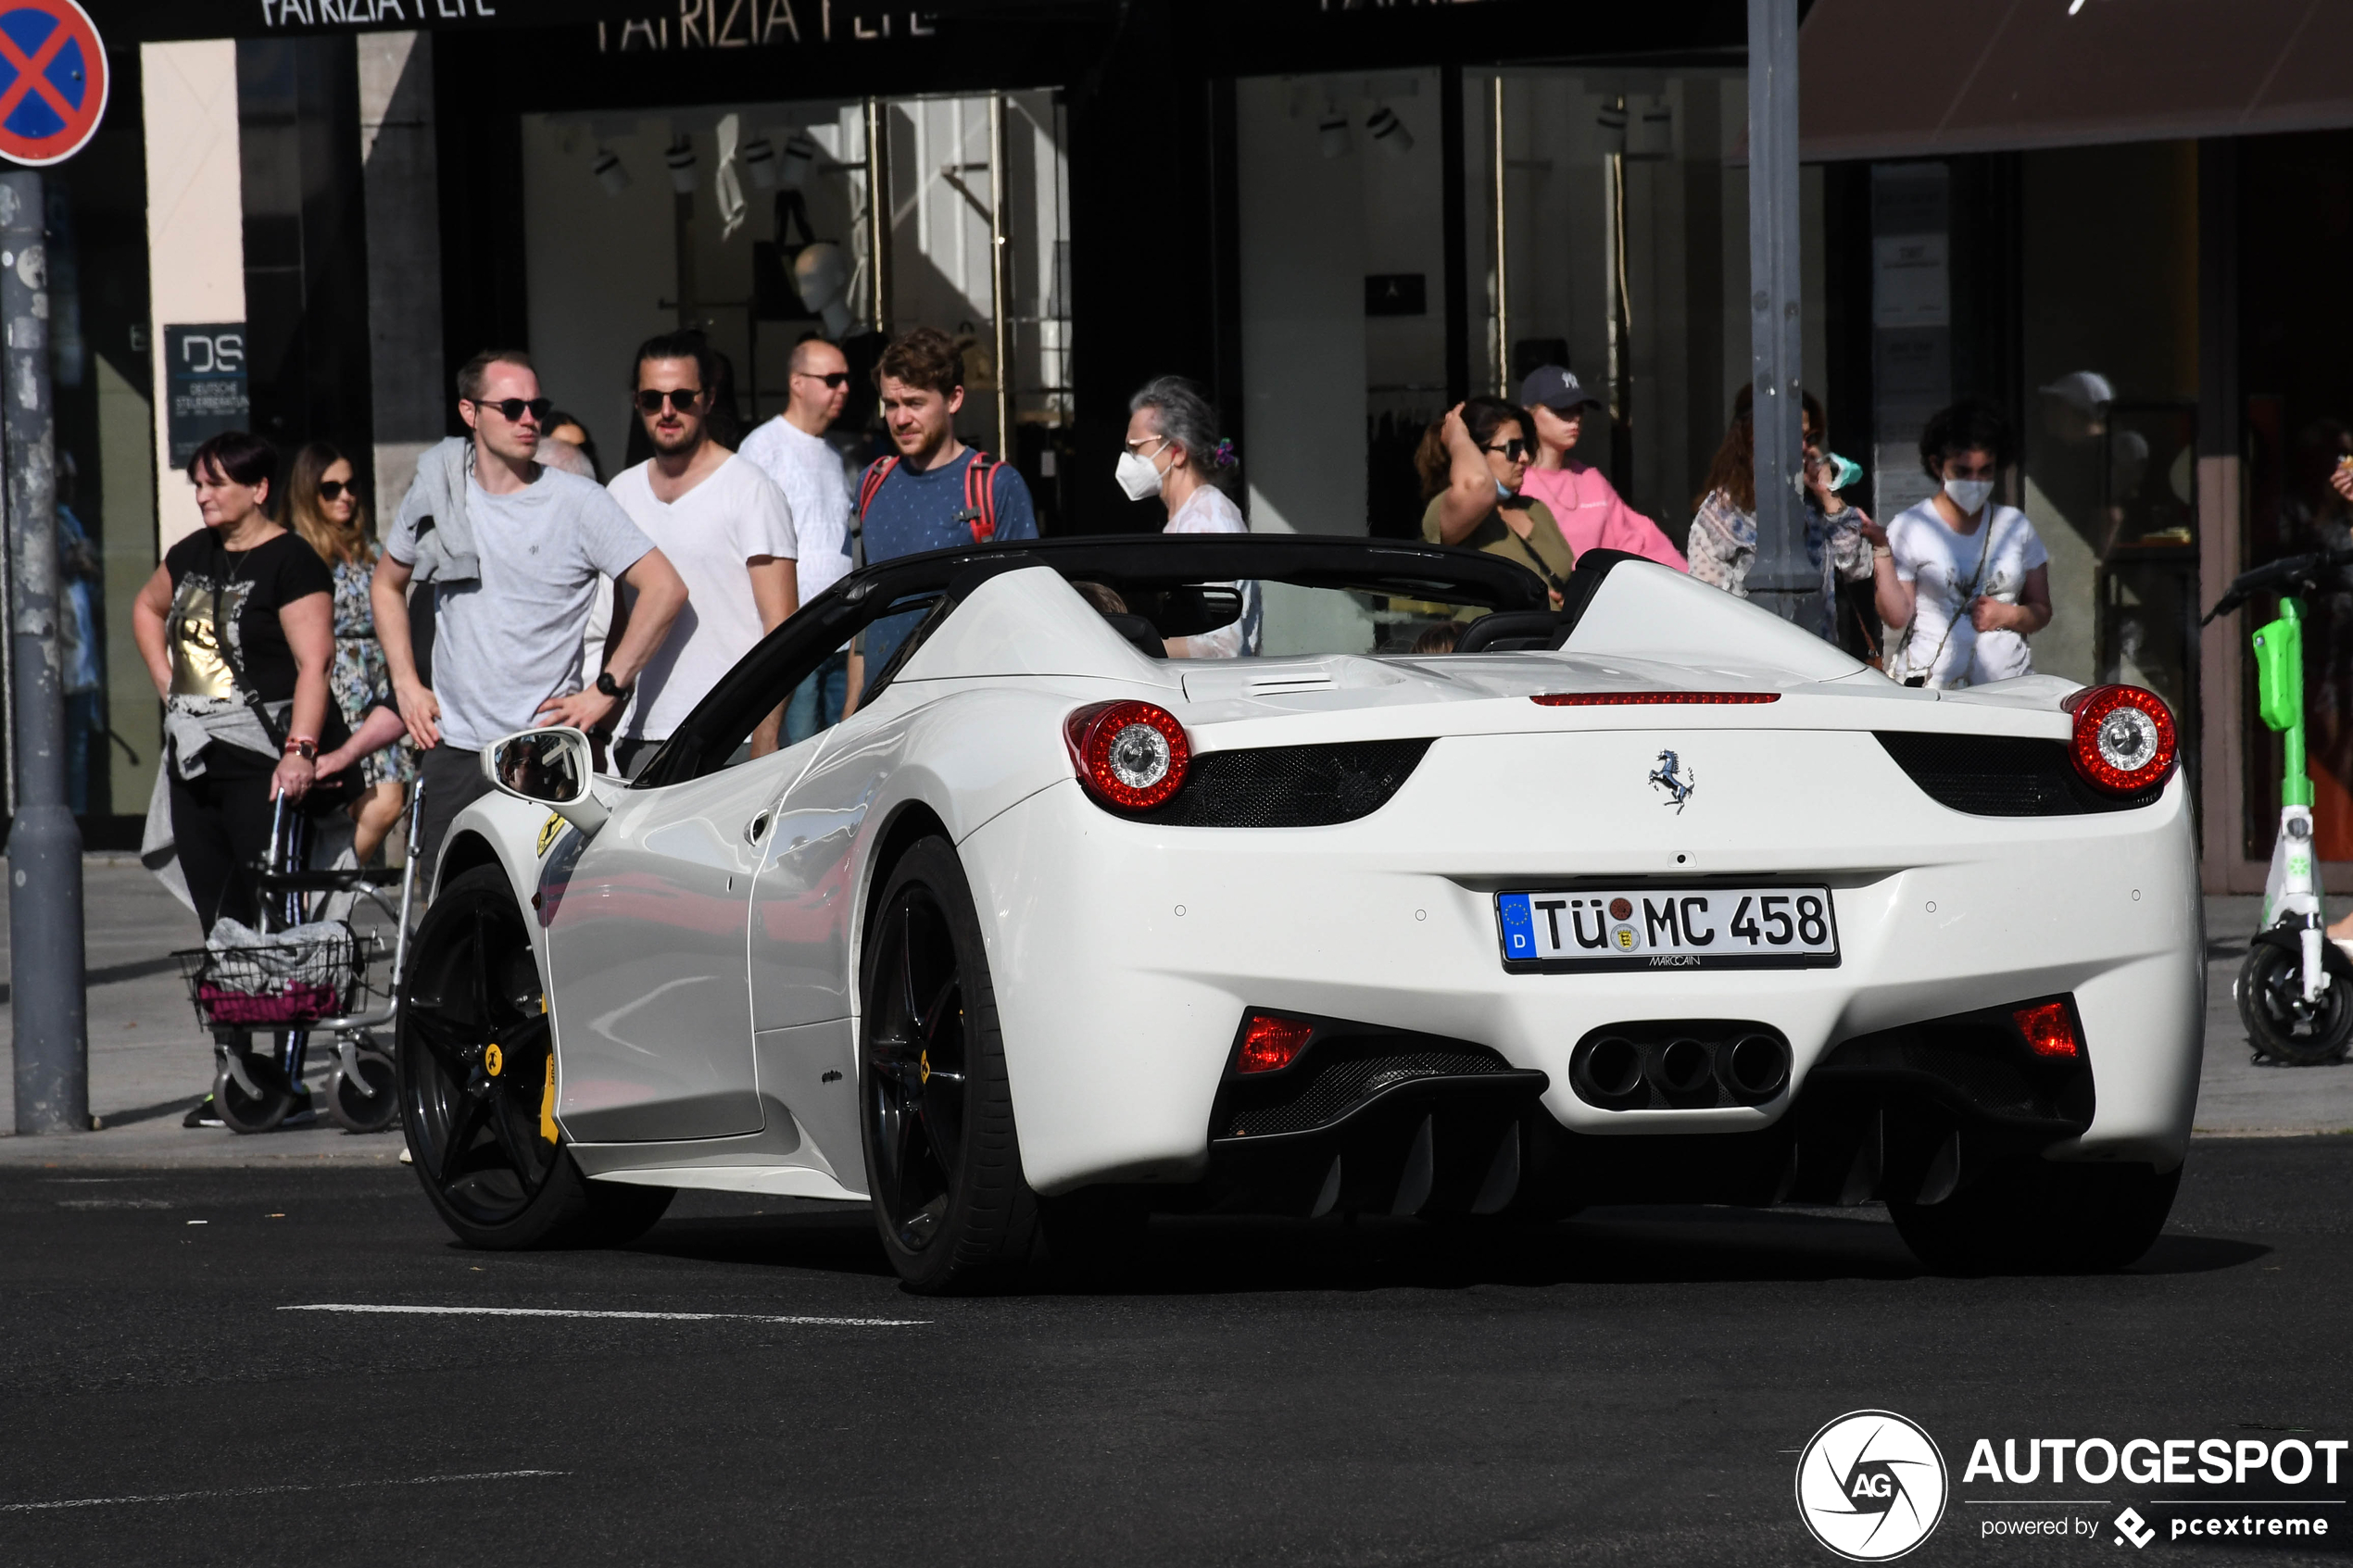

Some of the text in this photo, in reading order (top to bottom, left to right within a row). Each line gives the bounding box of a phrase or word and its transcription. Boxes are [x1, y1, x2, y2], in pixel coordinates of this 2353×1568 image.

[182, 334, 244, 372] DS
[1642, 897, 1715, 947] MC
[1730, 896, 1828, 946] 458
[1514, 935, 1527, 948] D
